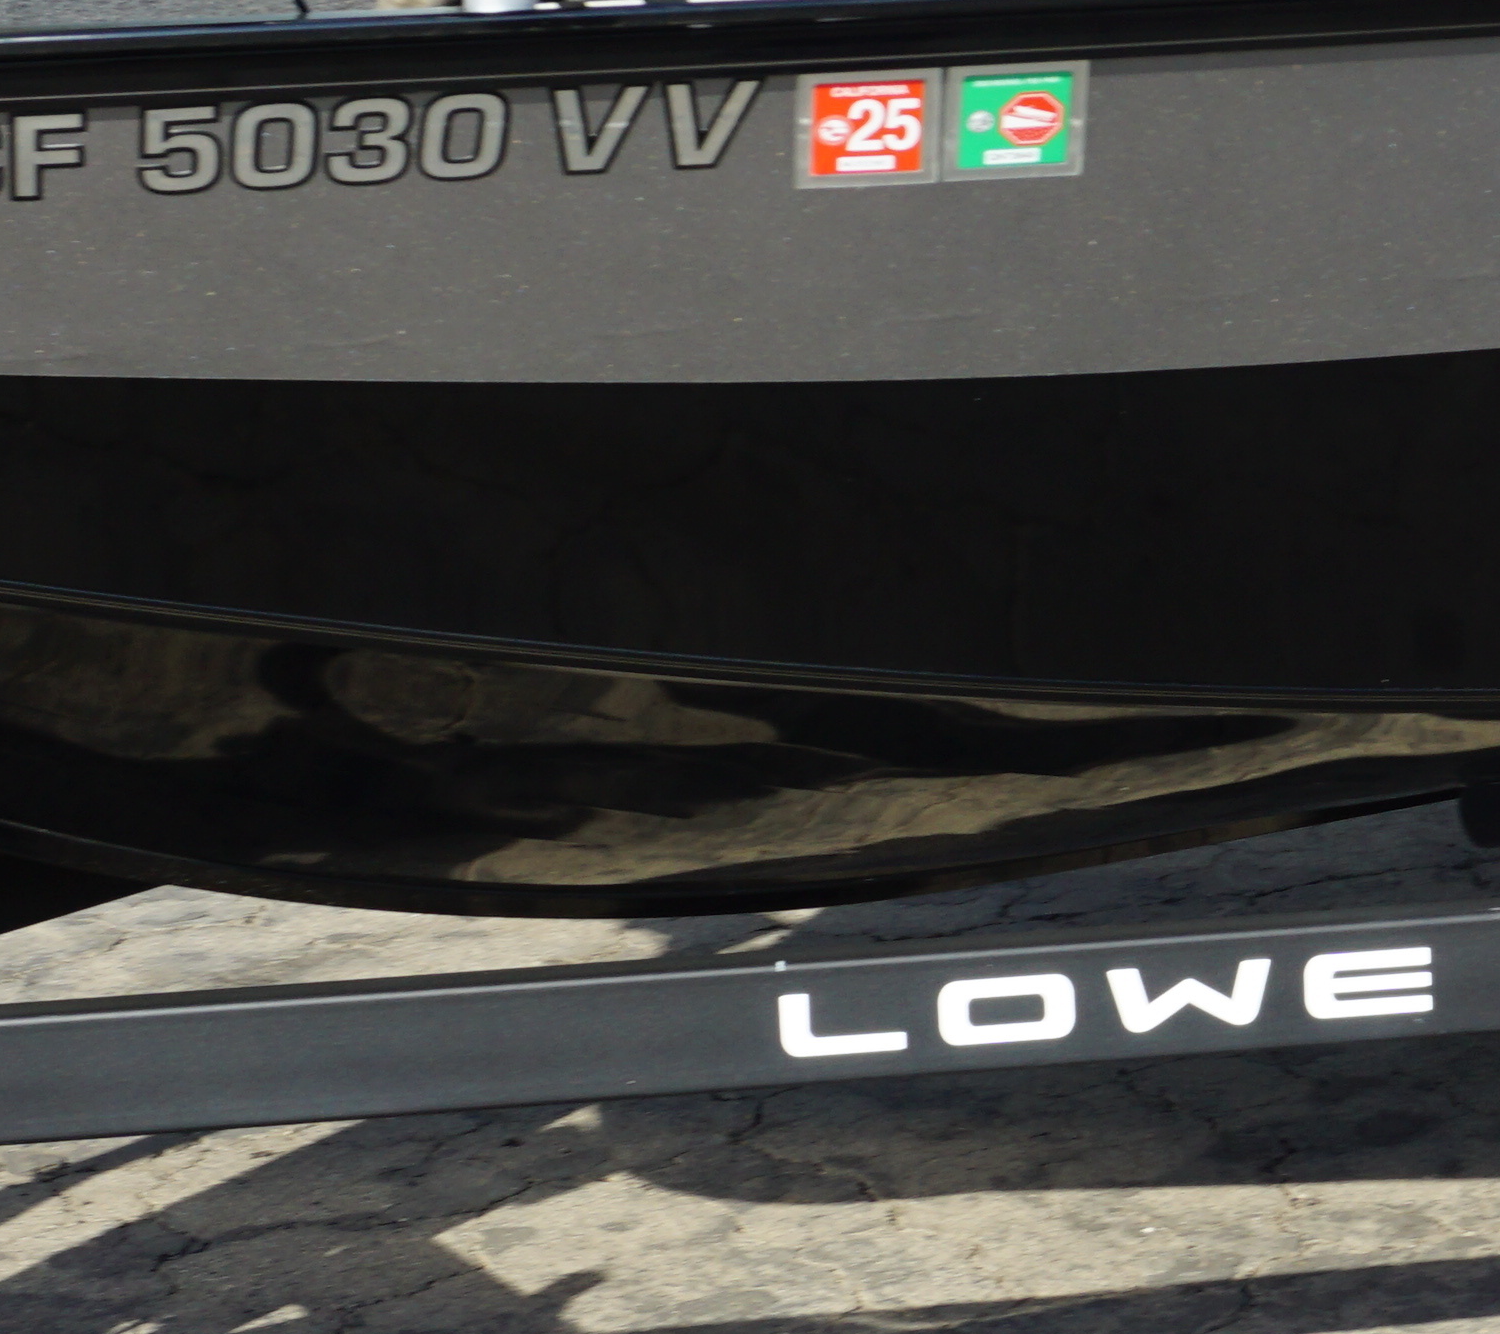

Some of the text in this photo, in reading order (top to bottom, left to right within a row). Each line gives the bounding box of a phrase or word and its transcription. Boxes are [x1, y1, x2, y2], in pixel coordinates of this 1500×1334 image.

[136, 89, 512, 197] 5030
[845, 97, 922, 152] 25
[777, 946, 1434, 1058] LOWE
